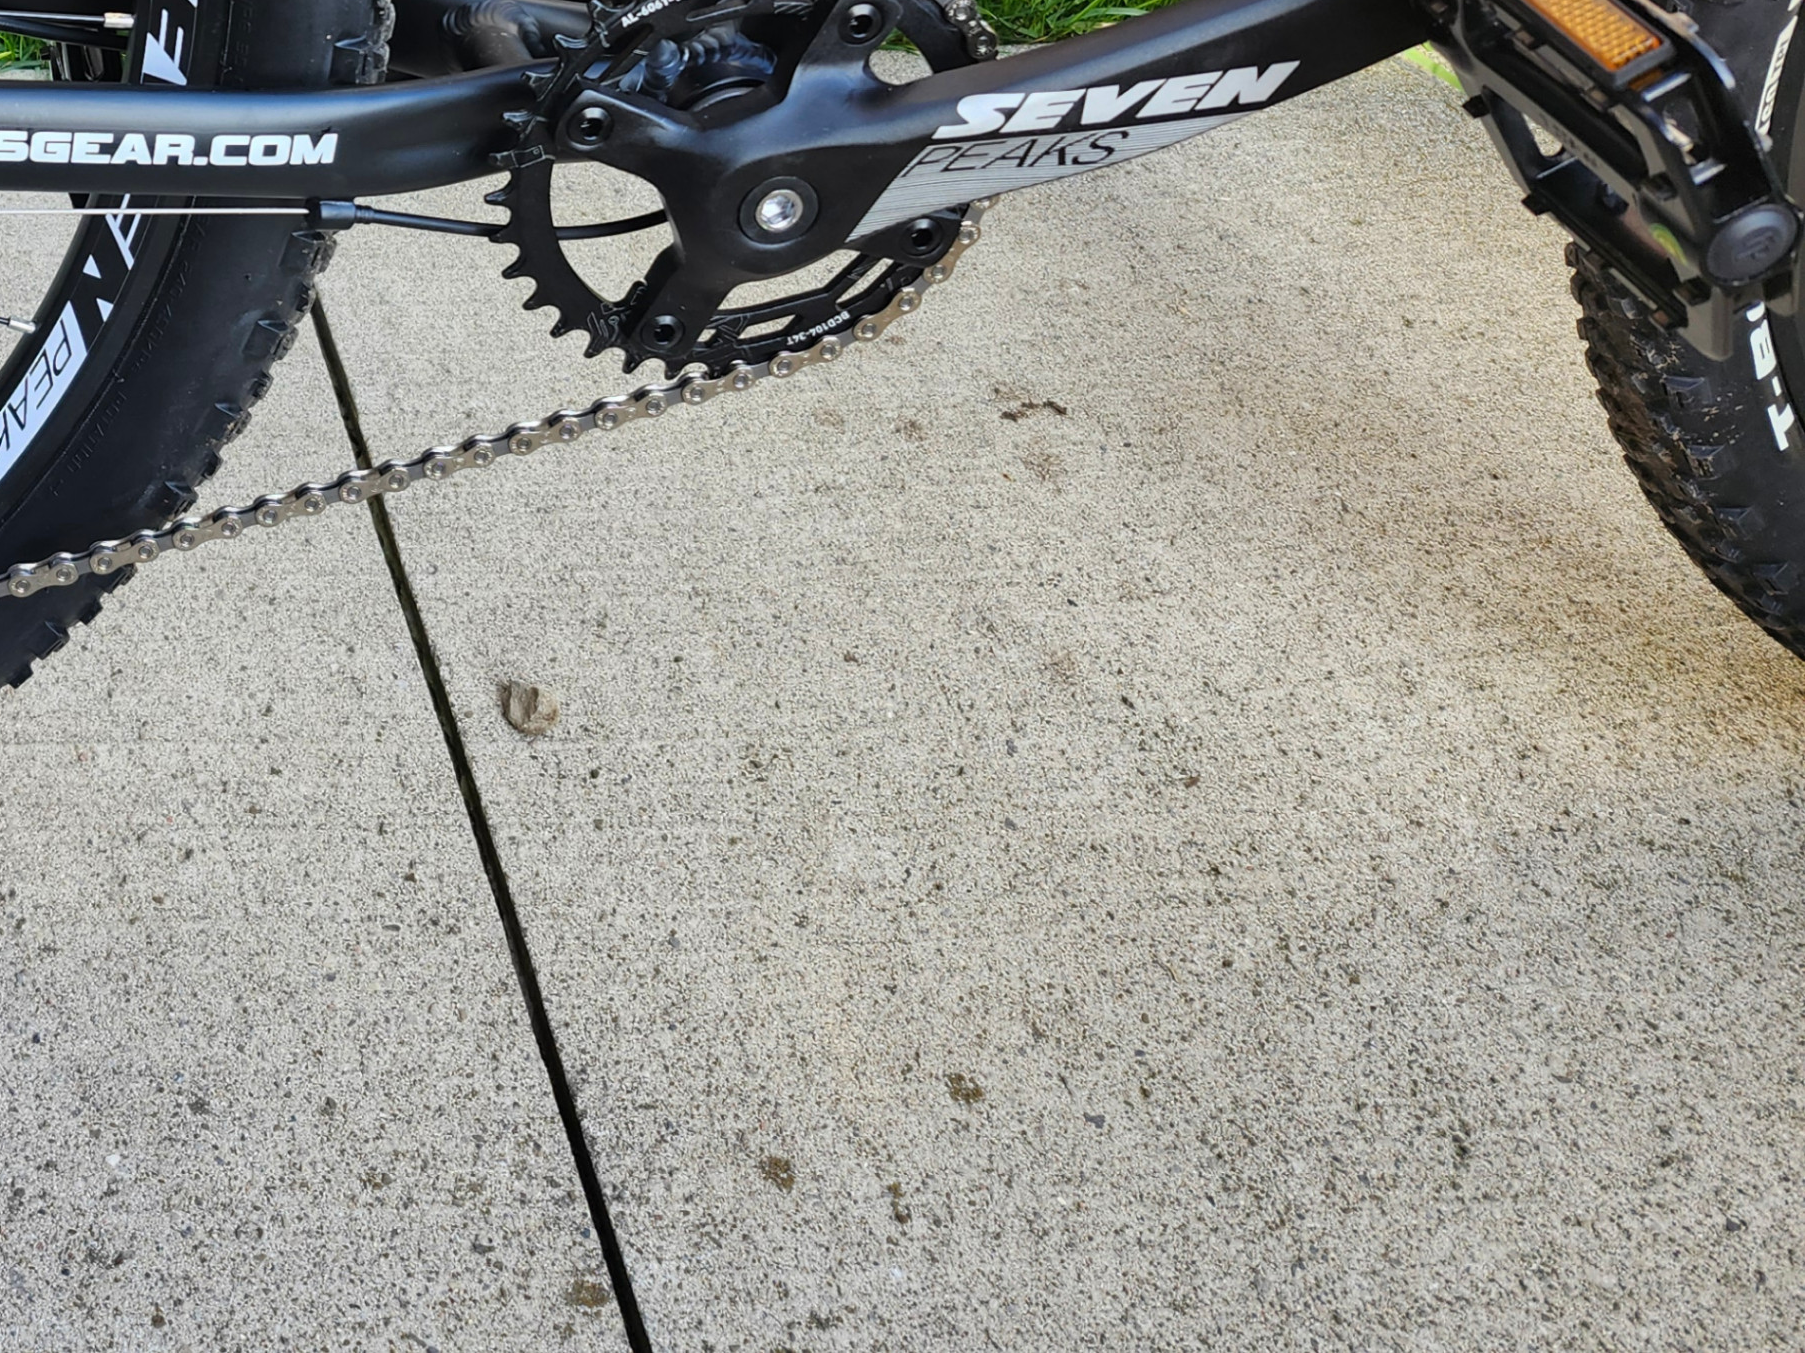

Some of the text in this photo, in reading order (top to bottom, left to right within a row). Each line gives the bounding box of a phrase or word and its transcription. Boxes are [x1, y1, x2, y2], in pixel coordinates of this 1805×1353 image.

[932, 60, 1301, 139] SEVEN
[900, 130, 1129, 178] PEAKS
[786, 310, 851, 346] BCD104-34T
